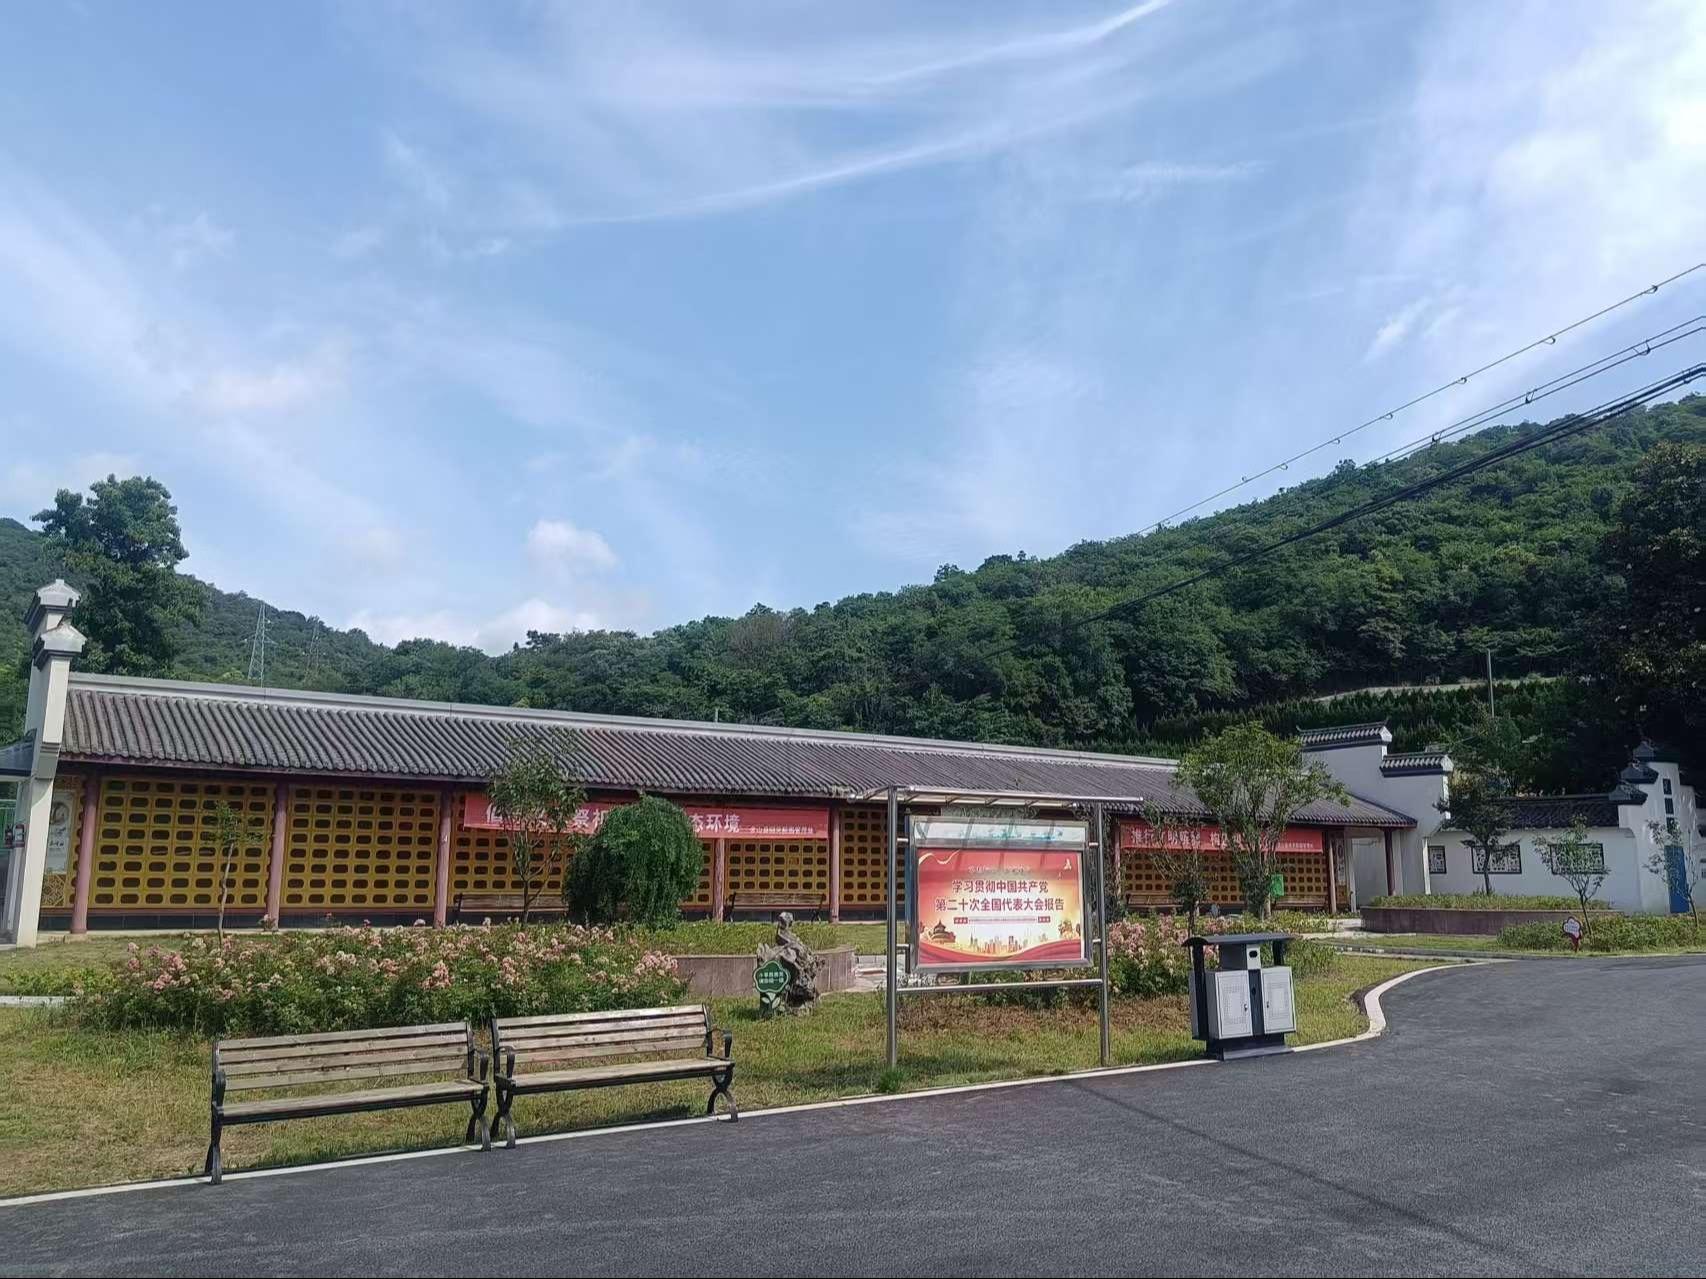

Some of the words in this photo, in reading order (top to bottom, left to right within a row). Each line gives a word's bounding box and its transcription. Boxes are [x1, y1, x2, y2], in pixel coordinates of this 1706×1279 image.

[952, 880, 1048, 893] 学习贯彻中国共产党
[935, 898, 1064, 911] 第二十次全国代表大会报告
